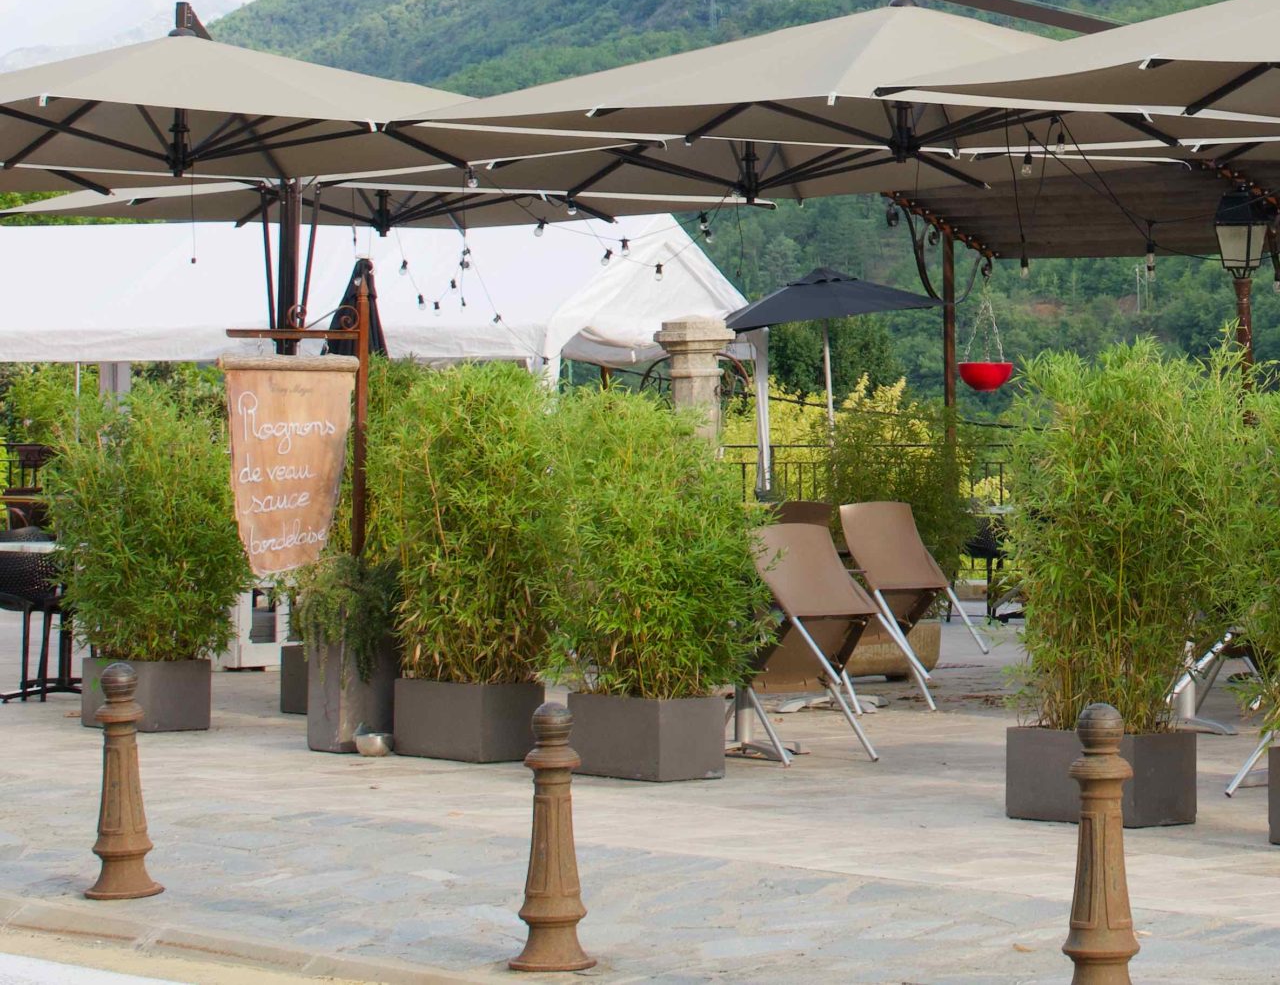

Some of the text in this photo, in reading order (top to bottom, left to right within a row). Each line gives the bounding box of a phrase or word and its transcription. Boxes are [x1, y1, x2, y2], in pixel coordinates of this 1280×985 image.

[238, 391, 335, 454] Rognons
[240, 454, 315, 484] de veau
[244, 490, 310, 514] sauce
[250, 519, 327, 555] bordelaise
